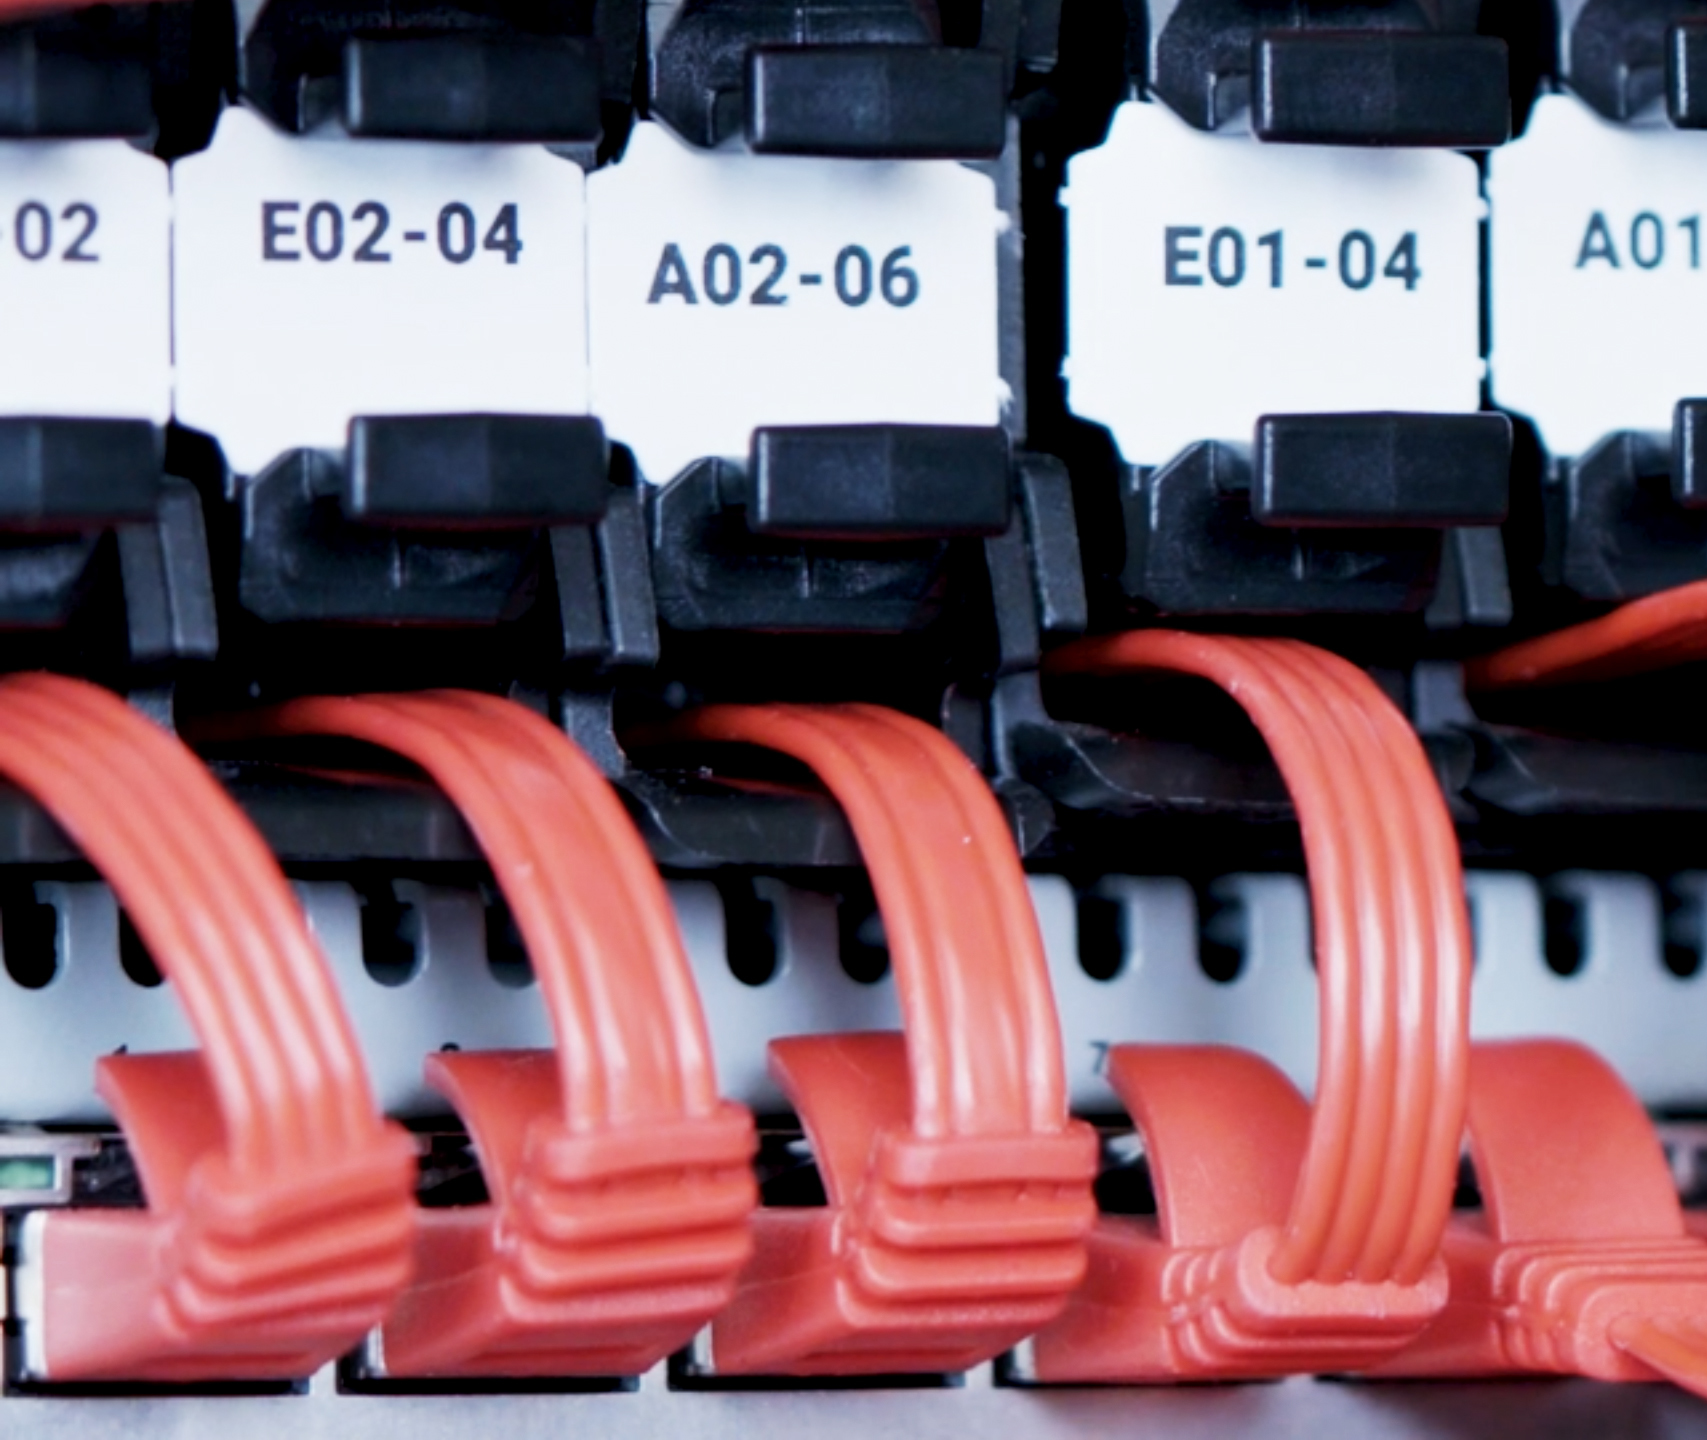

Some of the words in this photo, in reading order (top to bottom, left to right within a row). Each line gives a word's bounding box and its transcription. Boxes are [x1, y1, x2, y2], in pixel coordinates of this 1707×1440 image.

[12, 199, 100, 263] 02
[260, 199, 525, 265] E02-04
[1162, 225, 1423, 292] E01-04
[645, 242, 921, 309] A02-06
[1088, 1039, 1108, 1077] 7
